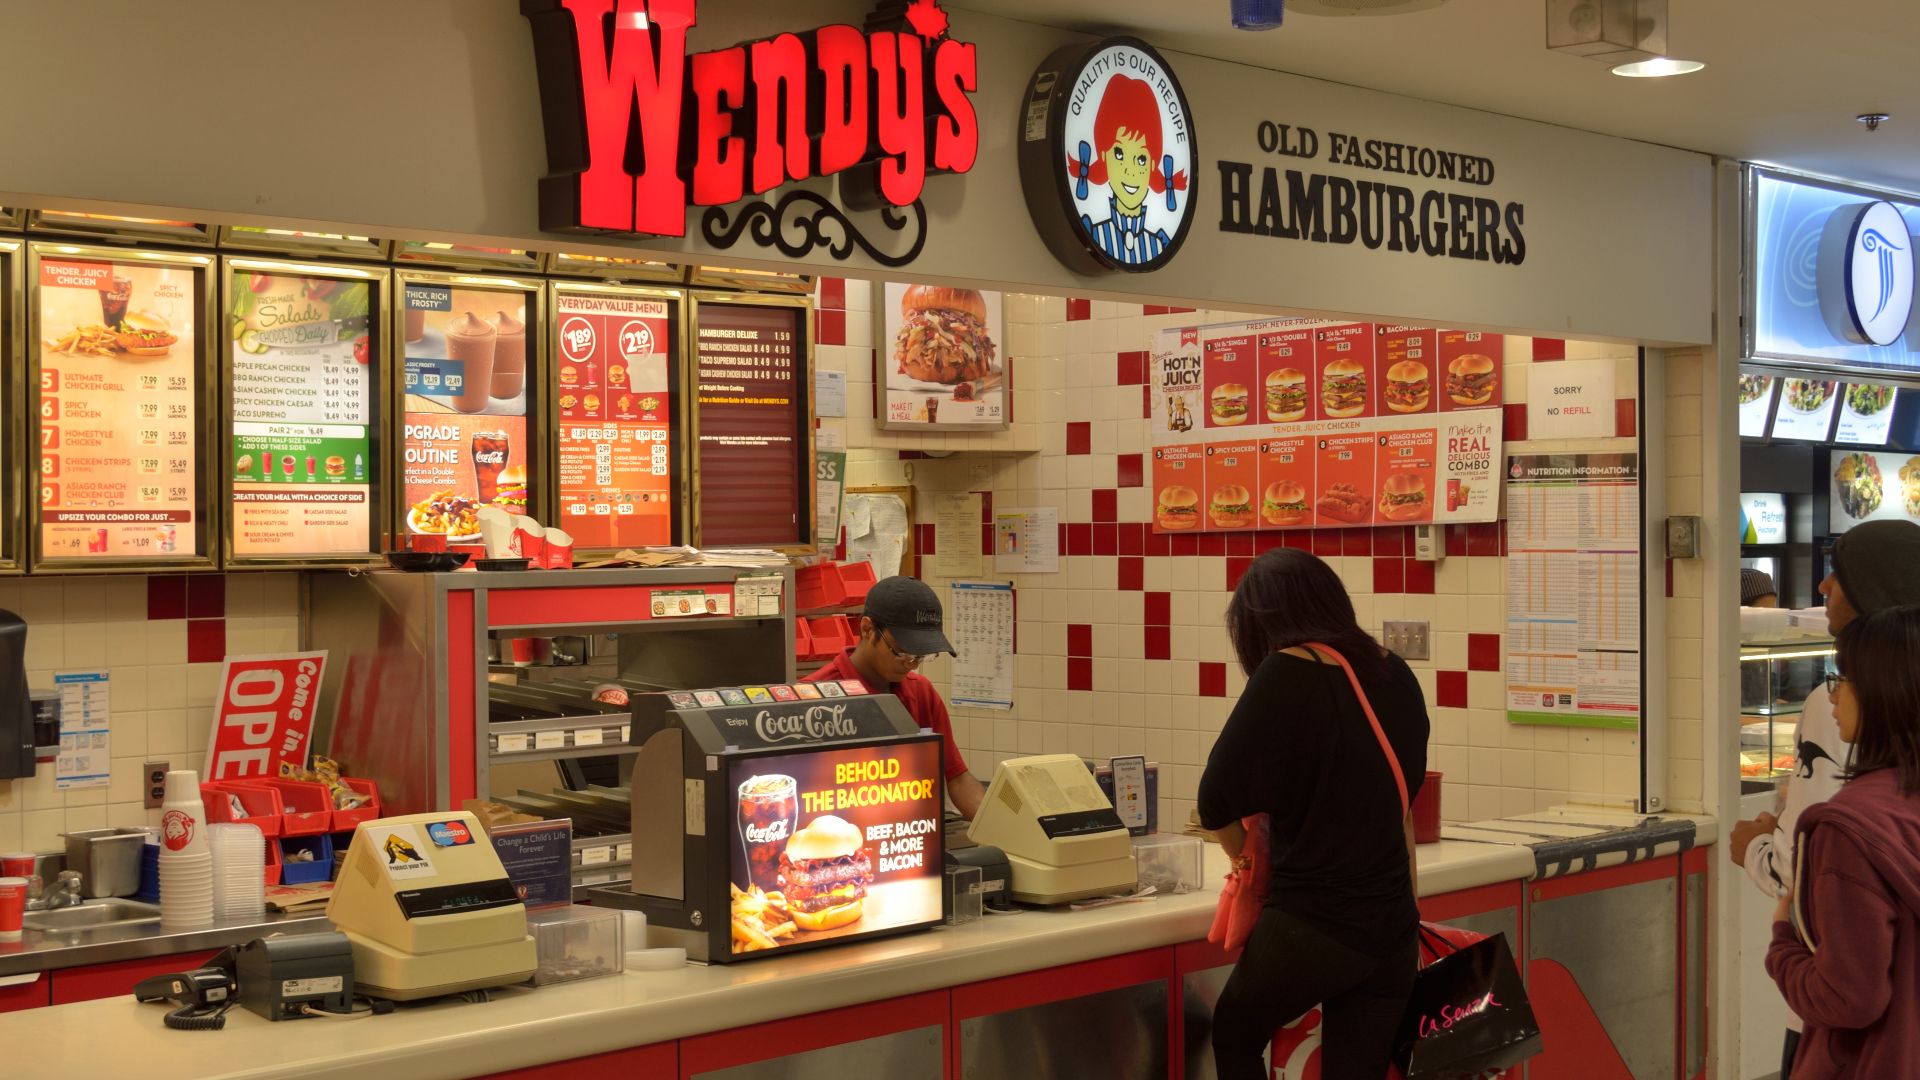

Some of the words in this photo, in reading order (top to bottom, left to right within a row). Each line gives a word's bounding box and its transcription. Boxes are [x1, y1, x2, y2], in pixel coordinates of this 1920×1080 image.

[1071, 53, 1110, 116] QUALITY
[1114, 51, 1126, 67] IS
[1129, 54, 1156, 82] OUR
[1156, 78, 1187, 144] RECIPE
[1257, 120, 1319, 159] OLD
[1328, 132, 1495, 186] FASHIONED
[1217, 160, 1526, 266] HAMBURGERS
[81, 269, 108, 278] JUICY
[57, 276, 96, 286] CHICKEN
[430, 292, 448, 300] RICH
[604, 301, 633, 312] VALUE
[636, 303, 663, 314] MENU
[259, 303, 322, 327] Salads
[295, 326, 328, 343] Daily
[700, 328, 736, 339] HAMBURGER
[736, 331, 758, 340] DELUXE
[1182, 331, 1197, 340] NEW
[737, 357, 752, 366] SALAD
[1163, 357, 1188, 371] HOT
[280, 364, 310, 372] CHICKEN
[41, 372, 52, 388] 5
[65, 373, 103, 382] ULTIMATE
[1163, 370, 1201, 386] JUICY
[65, 381, 101, 390] CHICKEN
[1163, 385, 1201, 393] CHEESEBURGERS
[1553, 386, 1582, 395] SORRY
[42, 401, 53, 416] 6
[65, 401, 88, 409] SPICY
[65, 410, 101, 418] CHICKEN
[1547, 408, 1559, 416] NO
[1563, 407, 1591, 415] REFILL
[1304, 424, 1326, 433] JUICY
[1327, 421, 1361, 430] CHICKEN
[1449, 425, 1476, 436] Make
[1477, 423, 1484, 435] it
[1486, 426, 1492, 435] a
[42, 429, 53, 445] 7
[65, 430, 113, 438] HOMESTYLE
[65, 438, 101, 446] CHICKEN
[1448, 437, 1490, 453] REAL
[1270, 446, 1296, 454] CHICKEN
[65, 457, 102, 465] CHICKEN
[1448, 453, 1491, 461] DELICIOUS
[42, 458, 53, 474] 8
[1448, 460, 1490, 471] COMBO
[1527, 467, 1571, 476] NUTRITION
[1572, 466, 1630, 475] INFORMATION
[98, 483, 126, 491] RANCH
[42, 487, 53, 503] 9
[66, 491, 102, 499] CHICKEN
[288, 660, 317, 721] Come
[215, 669, 284, 780] OPE
[726, 718, 748, 727] Enjoy
[755, 704, 857, 743] Coca-Cola
[836, 758, 900, 785] BEHOLD
[802, 789, 835, 813] THE
[434, 829, 466, 838] Maestro
[746, 818, 789, 843] Coca-Cola
[866, 824, 895, 841] BEEF,
[895, 818, 937, 836] BACON
[497, 837, 522, 847] Change
[553, 832, 566, 840] Life
[520, 846, 544, 854] Forever
[879, 841, 889, 856] &
[890, 837, 924, 854] MORE
[879, 853, 922, 873] BACON!
